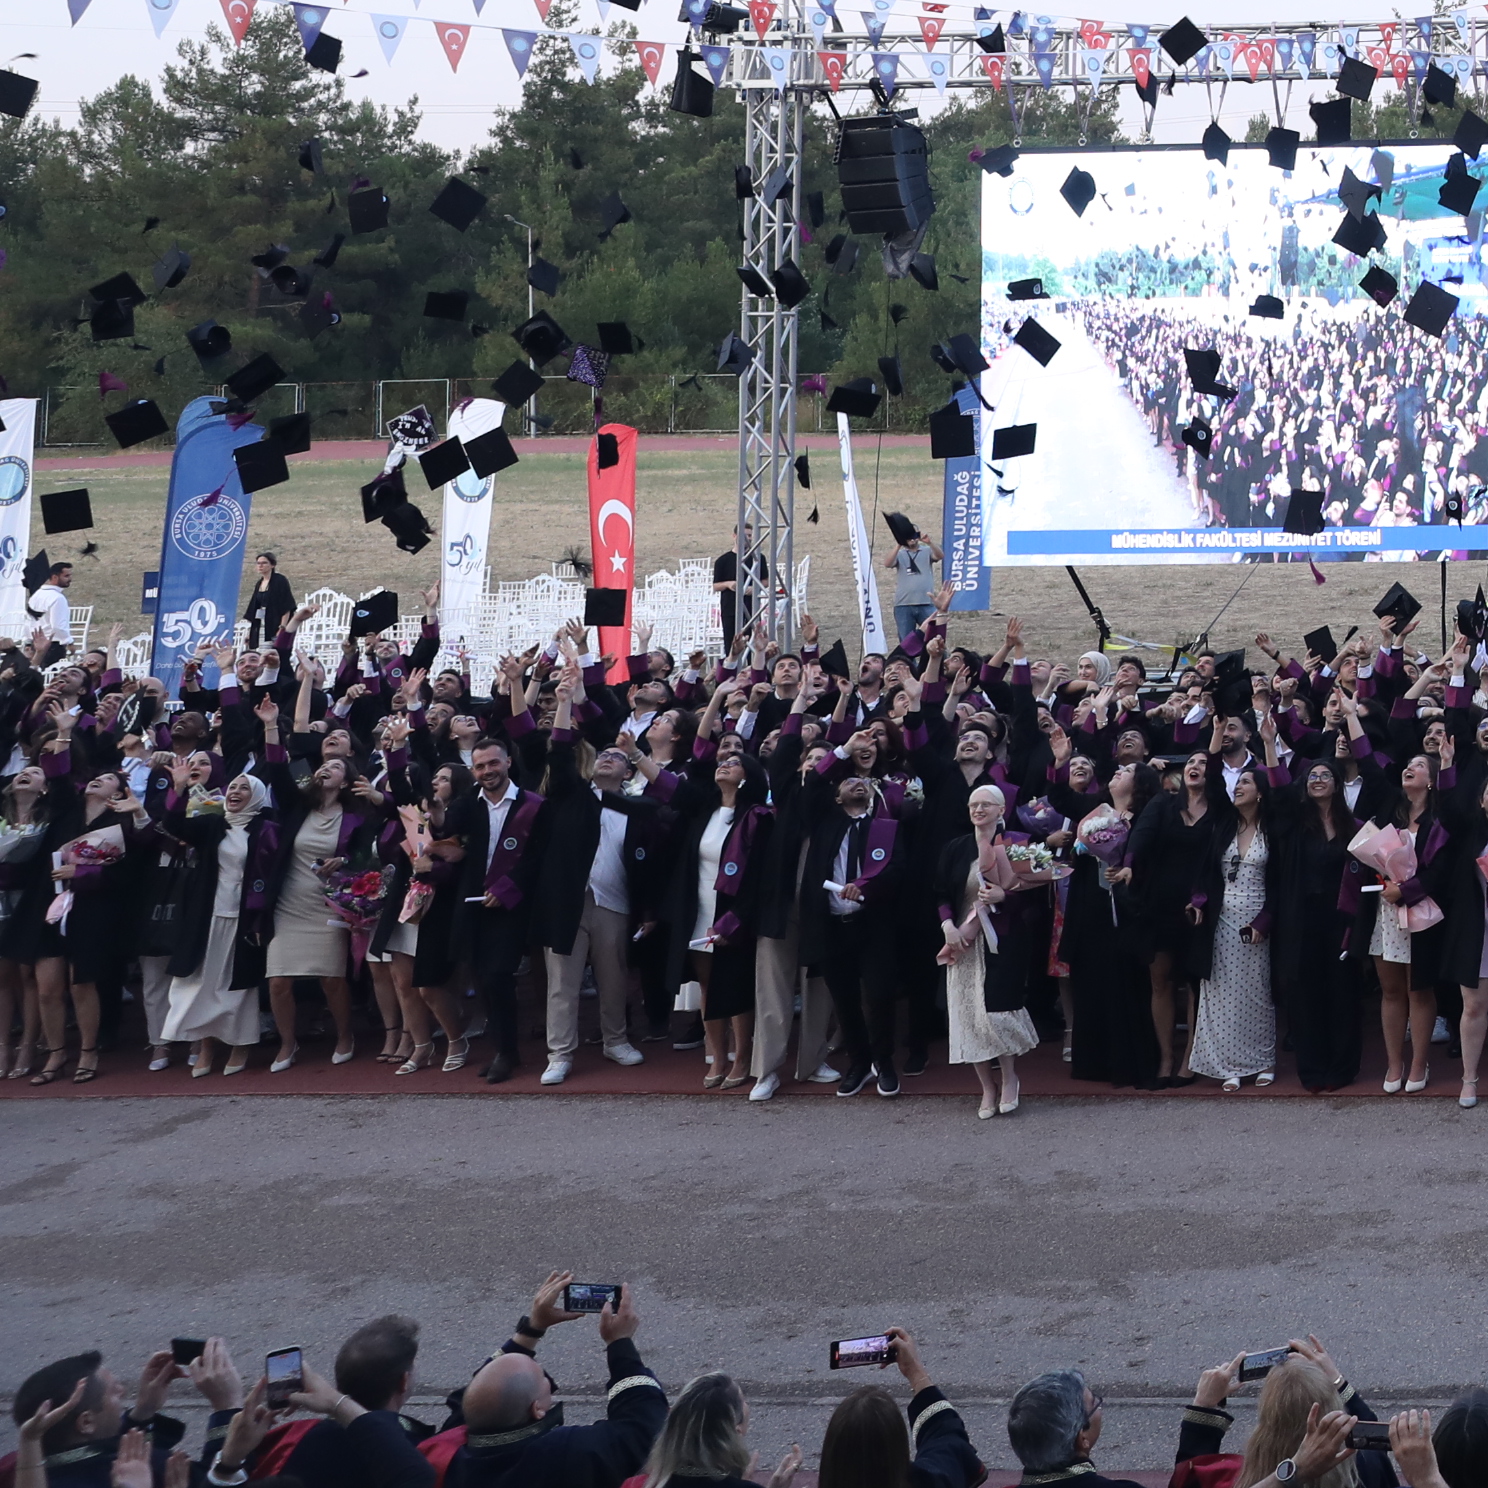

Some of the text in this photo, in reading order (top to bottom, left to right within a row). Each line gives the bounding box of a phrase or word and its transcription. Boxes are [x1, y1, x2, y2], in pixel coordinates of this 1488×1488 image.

[953, 470, 971, 536] ULUDAĞ
[194, 550, 218, 558] 1975
[962, 470, 982, 591] ÜNİVERSİTESİ
[1111, 530, 1195, 549] MÜHENDİSLİK
[1196, 530, 1262, 548] FAKÜLTESİ
[1335, 529, 1381, 546] TÖRENİ
[951, 538, 967, 592] BURSA
